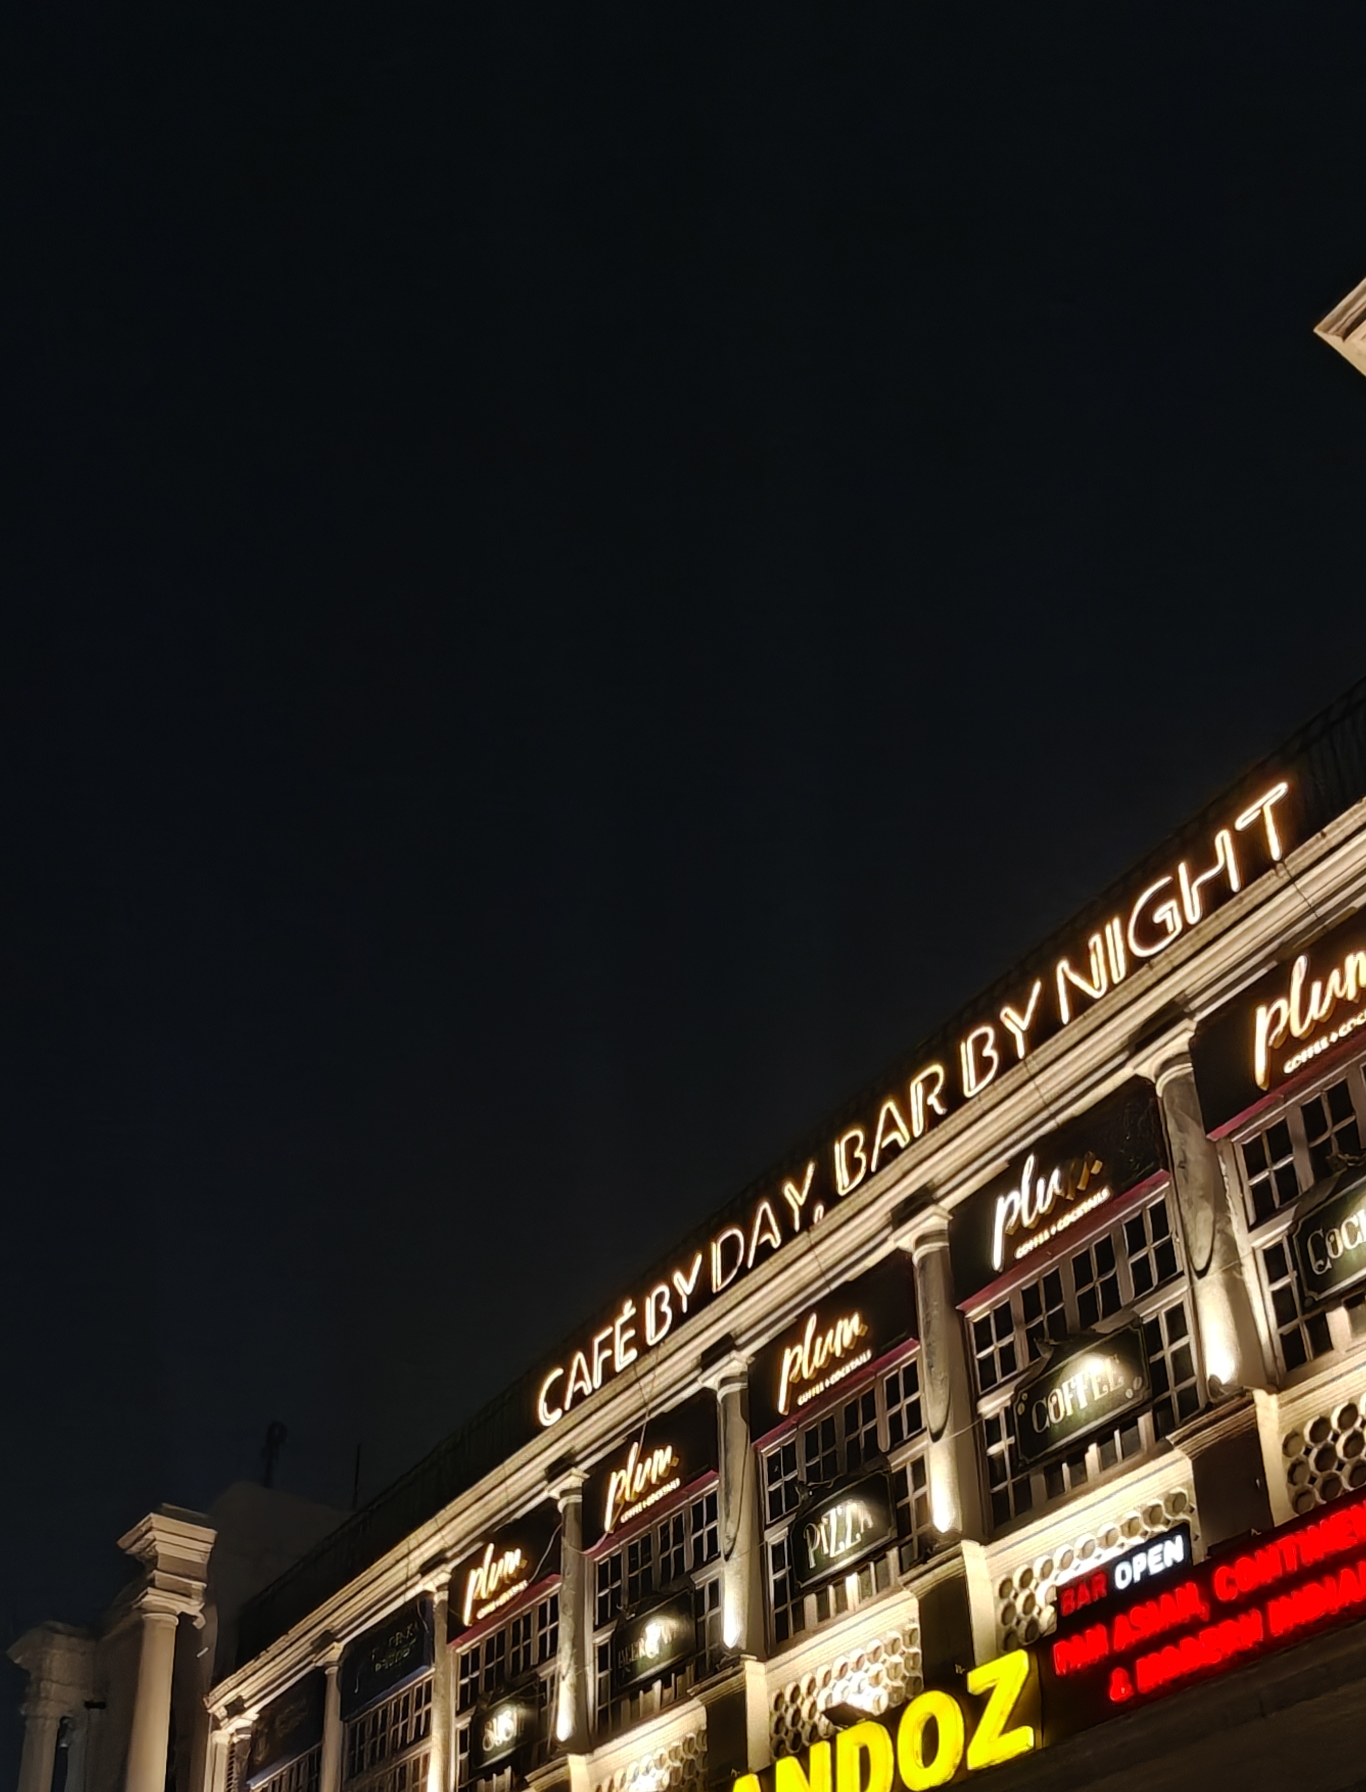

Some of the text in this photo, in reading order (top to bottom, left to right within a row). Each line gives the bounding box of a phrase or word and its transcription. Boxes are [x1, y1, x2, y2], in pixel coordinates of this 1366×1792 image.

[538, 782, 1289, 1427] CAFÉ BY DAY, BAR BY NIGHT
[778, 1312, 867, 1415] plum
[604, 1442, 678, 1533] plum
[803, 1499, 874, 1569] PIZZA
[1060, 1533, 1184, 1616] BAR OPEN
[463, 1543, 526, 1627] plum
[1110, 1666, 1133, 1702] &
